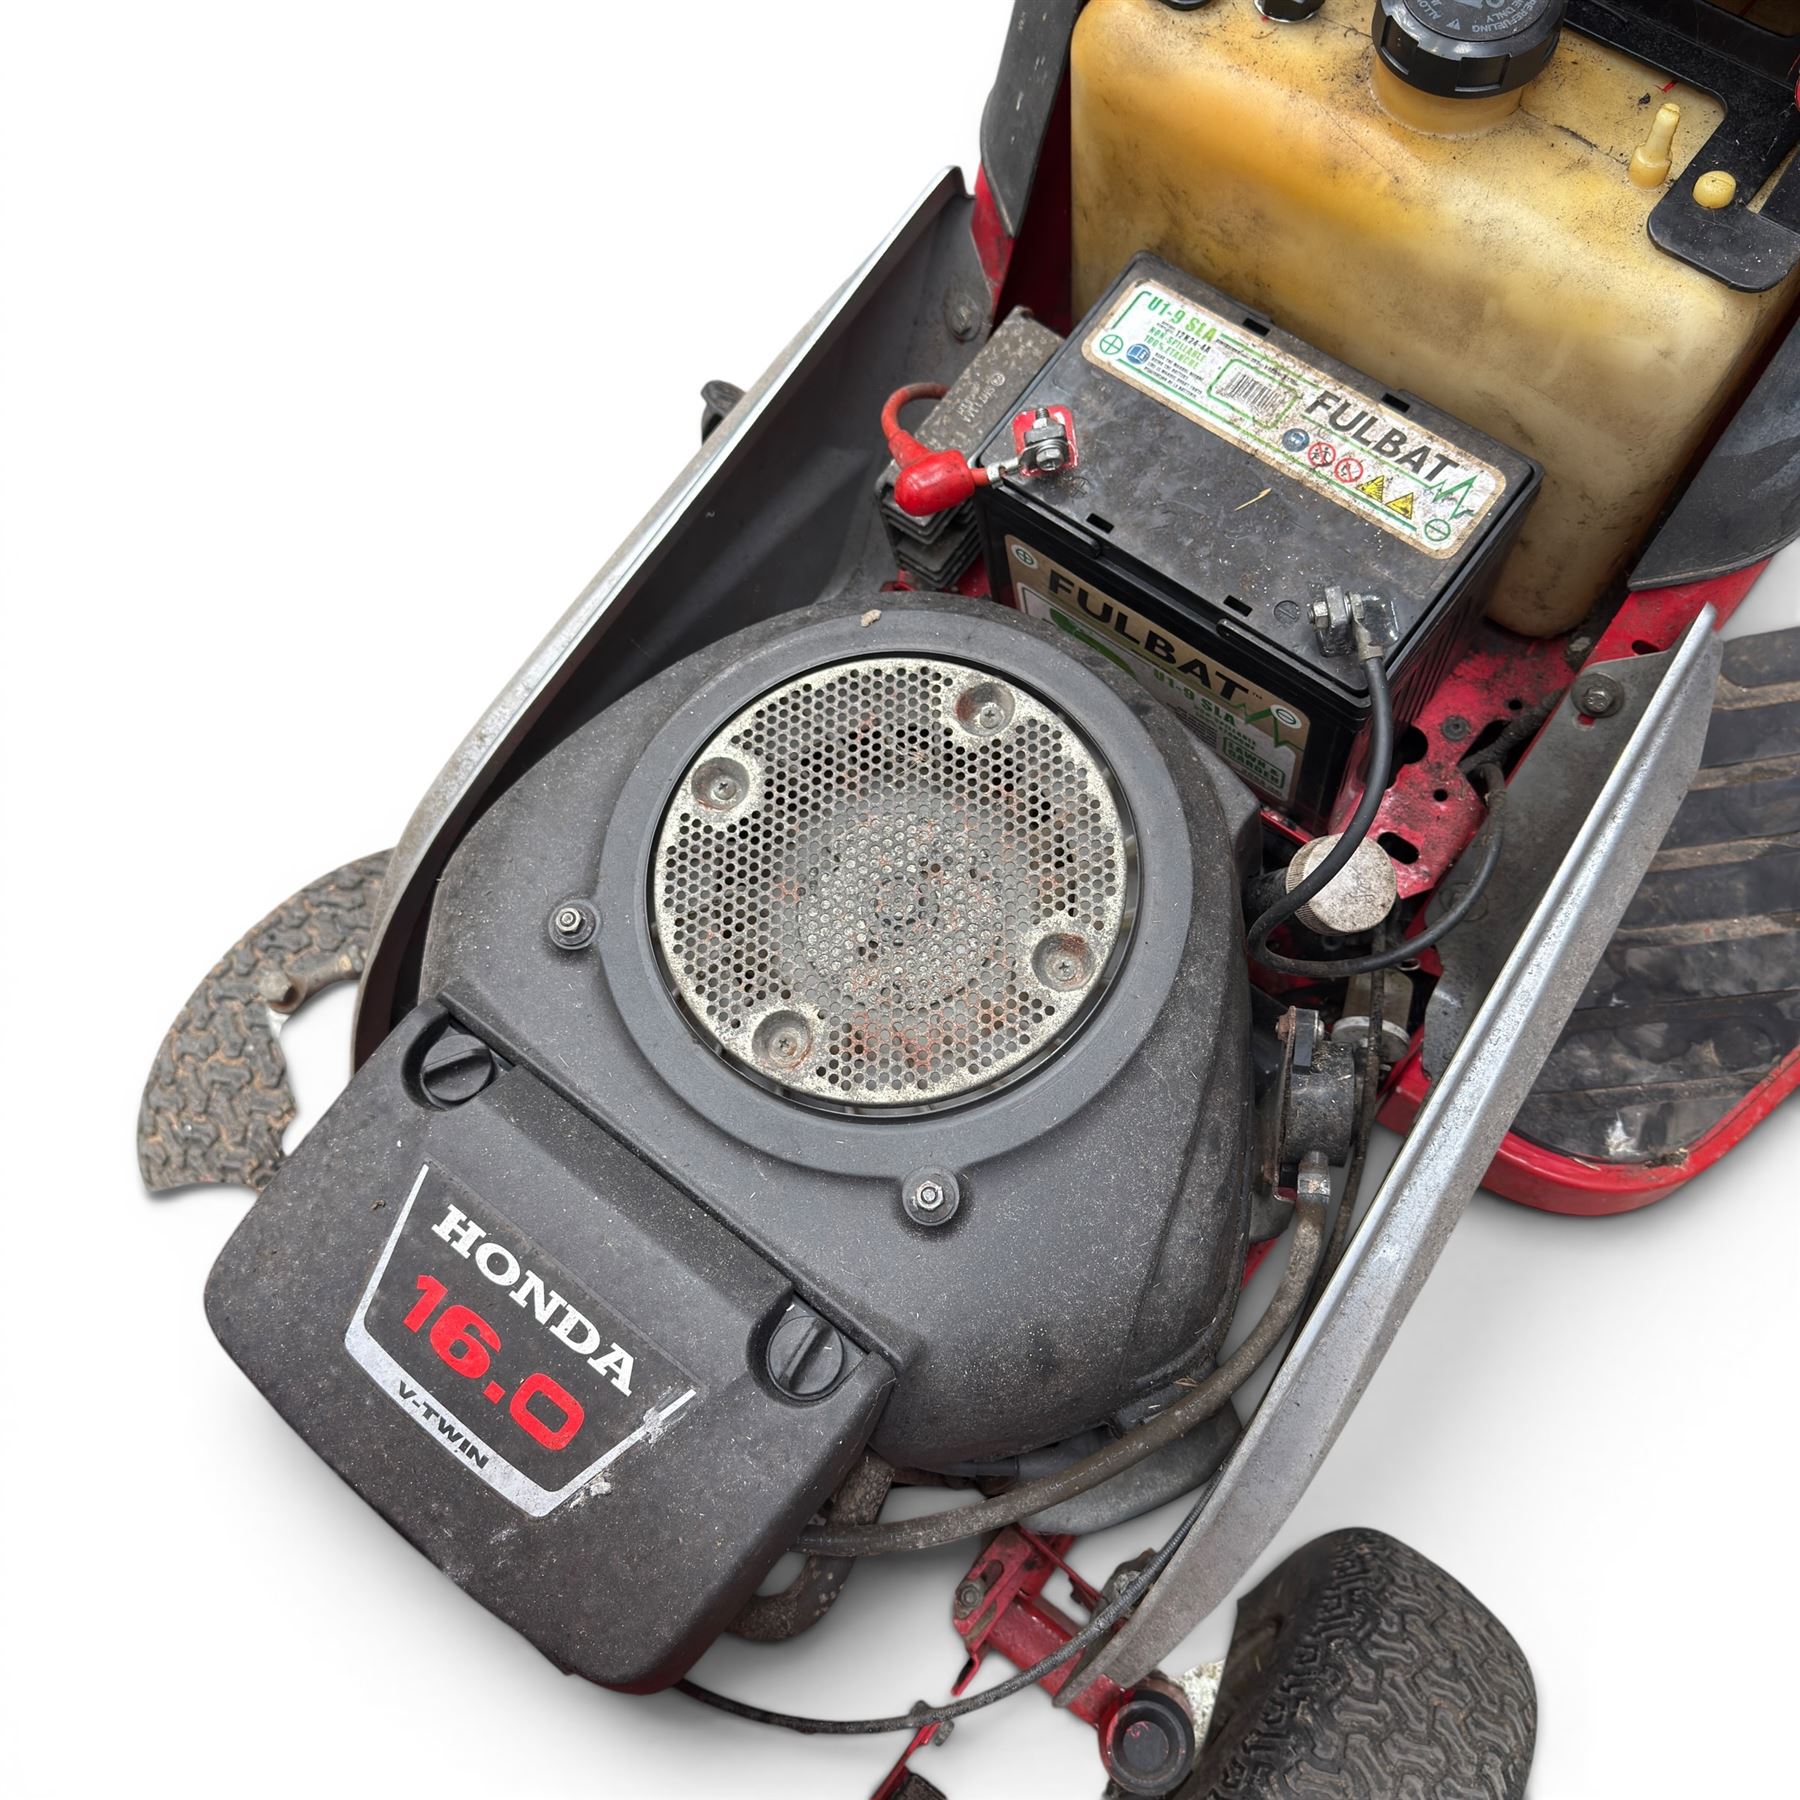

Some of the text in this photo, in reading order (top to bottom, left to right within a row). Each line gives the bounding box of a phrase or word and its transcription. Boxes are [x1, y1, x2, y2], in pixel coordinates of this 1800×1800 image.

[1472, 9, 1528, 32] REFUELING
[1487, 6, 1515, 23] ONLY
[1148, 296, 1185, 324] U1-9
[1185, 317, 1217, 342] SLA
[1305, 391, 1460, 481] FULBAT
[1048, 569, 1250, 701] FULBAT
[1153, 669, 1236, 726] U1-9 SLA
[1228, 741, 1266, 768] LAWN
[1228, 749, 1279, 784] GARDEN
[432, 1204, 634, 1397] HONDA
[403, 1274, 584, 1451] 16.0
[399, 1381, 489, 1468] V-TWIN
